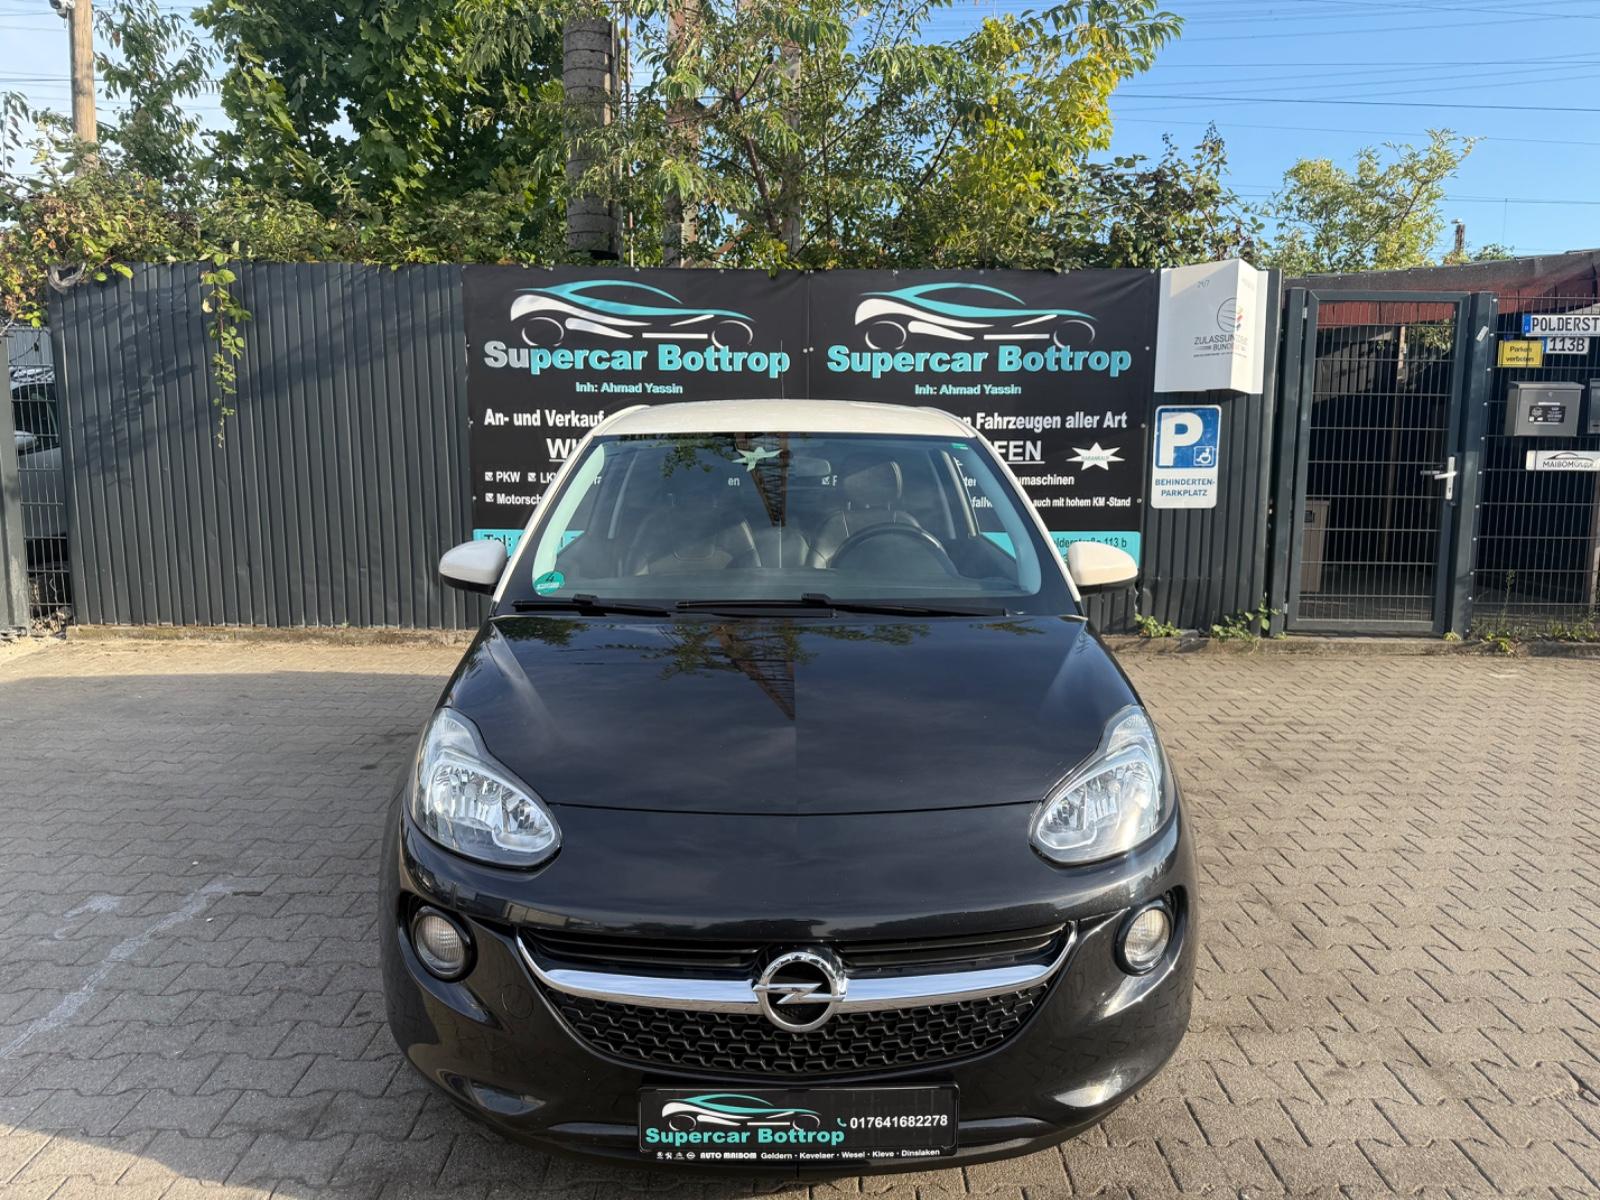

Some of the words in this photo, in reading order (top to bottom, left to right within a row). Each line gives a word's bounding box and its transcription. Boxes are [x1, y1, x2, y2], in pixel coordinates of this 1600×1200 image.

[1549, 337, 1585, 352] 113B
[484, 341, 648, 375] Supercar
[658, 344, 790, 378] Bottrop
[827, 345, 988, 378] Supercar
[998, 345, 1132, 377] Bottrop
[575, 382, 598, 392] Inh:
[601, 383, 642, 393] Ahmad
[644, 383, 683, 394] Yassin
[915, 385, 937, 394] Inh:
[940, 385, 980, 395] Ahmad
[983, 385, 1022, 394] Yassin
[484, 408, 509, 426] An-
[513, 410, 541, 426] und
[976, 412, 1061, 433] Fahrzeugen
[1065, 412, 1098, 428] aller
[1103, 411, 1127, 428] Art
[1159, 412, 1203, 466] P
[546, 438, 583, 459] WI
[993, 440, 1042, 461] FEN
[496, 472, 521, 482] PKW
[540, 472, 560, 483] LK
[1155, 478, 1215, 486] BEHINDERTEN-
[496, 493, 542, 505] Motorsch
[1052, 497, 1064, 507] mit
[1066, 497, 1091, 507] hohem
[1092, 497, 1105, 507] KM
[850, 1115, 948, 1128] 017641682278
[646, 1128, 750, 1147] Supercar
[758, 1128, 845, 1146] Bottrop
[799, 1152, 834, 1160] Kevelaer
[841, 1151, 866, 1159] Wesel
